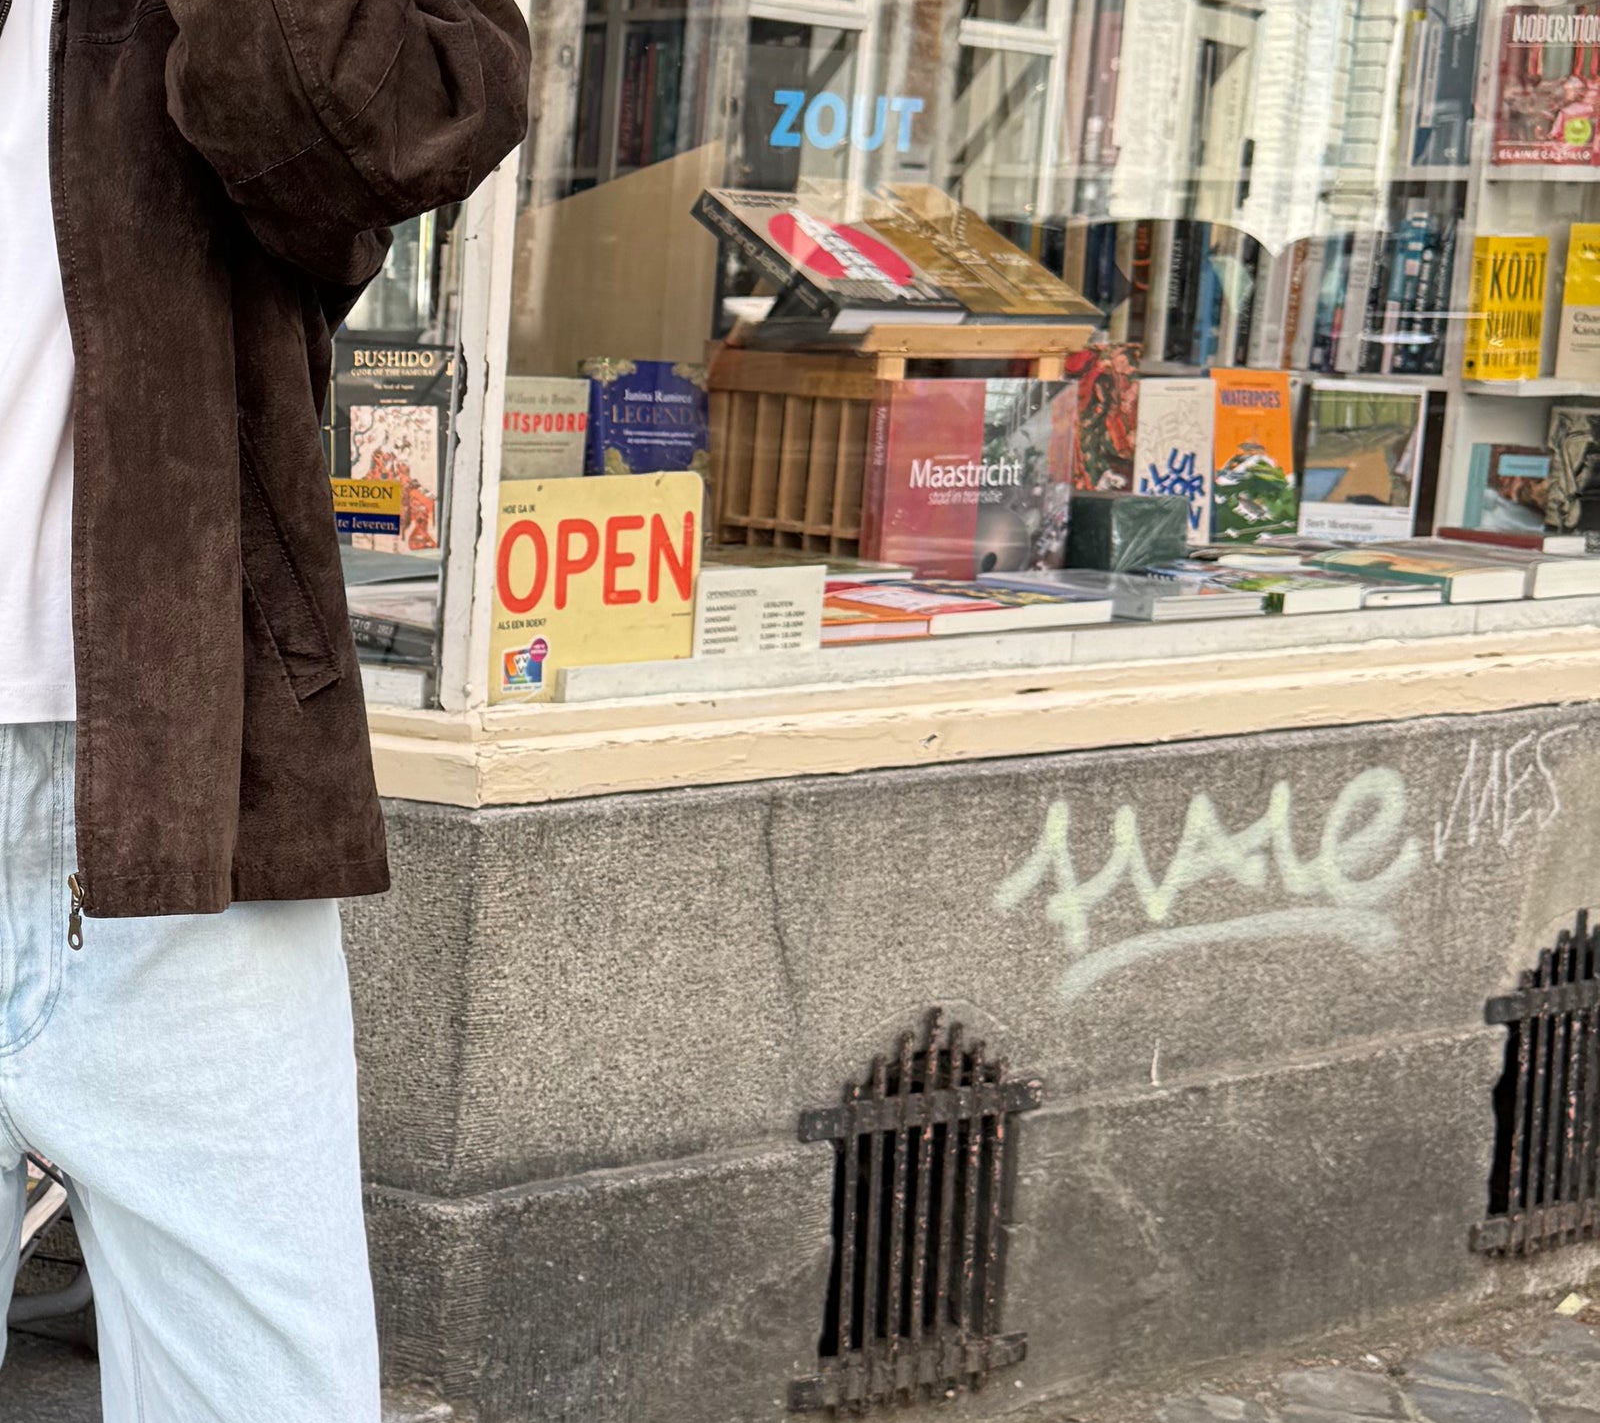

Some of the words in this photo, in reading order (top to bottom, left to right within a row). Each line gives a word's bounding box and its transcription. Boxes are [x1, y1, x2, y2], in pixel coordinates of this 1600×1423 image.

[769, 89, 924, 153] ZOUT
[353, 349, 435, 368] BUSHIDO
[624, 389, 653, 404] Janina
[1220, 389, 1282, 409] WATERPOES
[909, 456, 1023, 490] Maastricht
[502, 505, 516, 515] HOE
[517, 504, 528, 514] GA
[529, 504, 536, 513] IK
[352, 517, 398, 531] leveren.
[496, 510, 694, 615] OPEN
[497, 620, 510, 630] ALS
[511, 620, 524, 629] EEN
[525, 618, 547, 628] BOEK?
